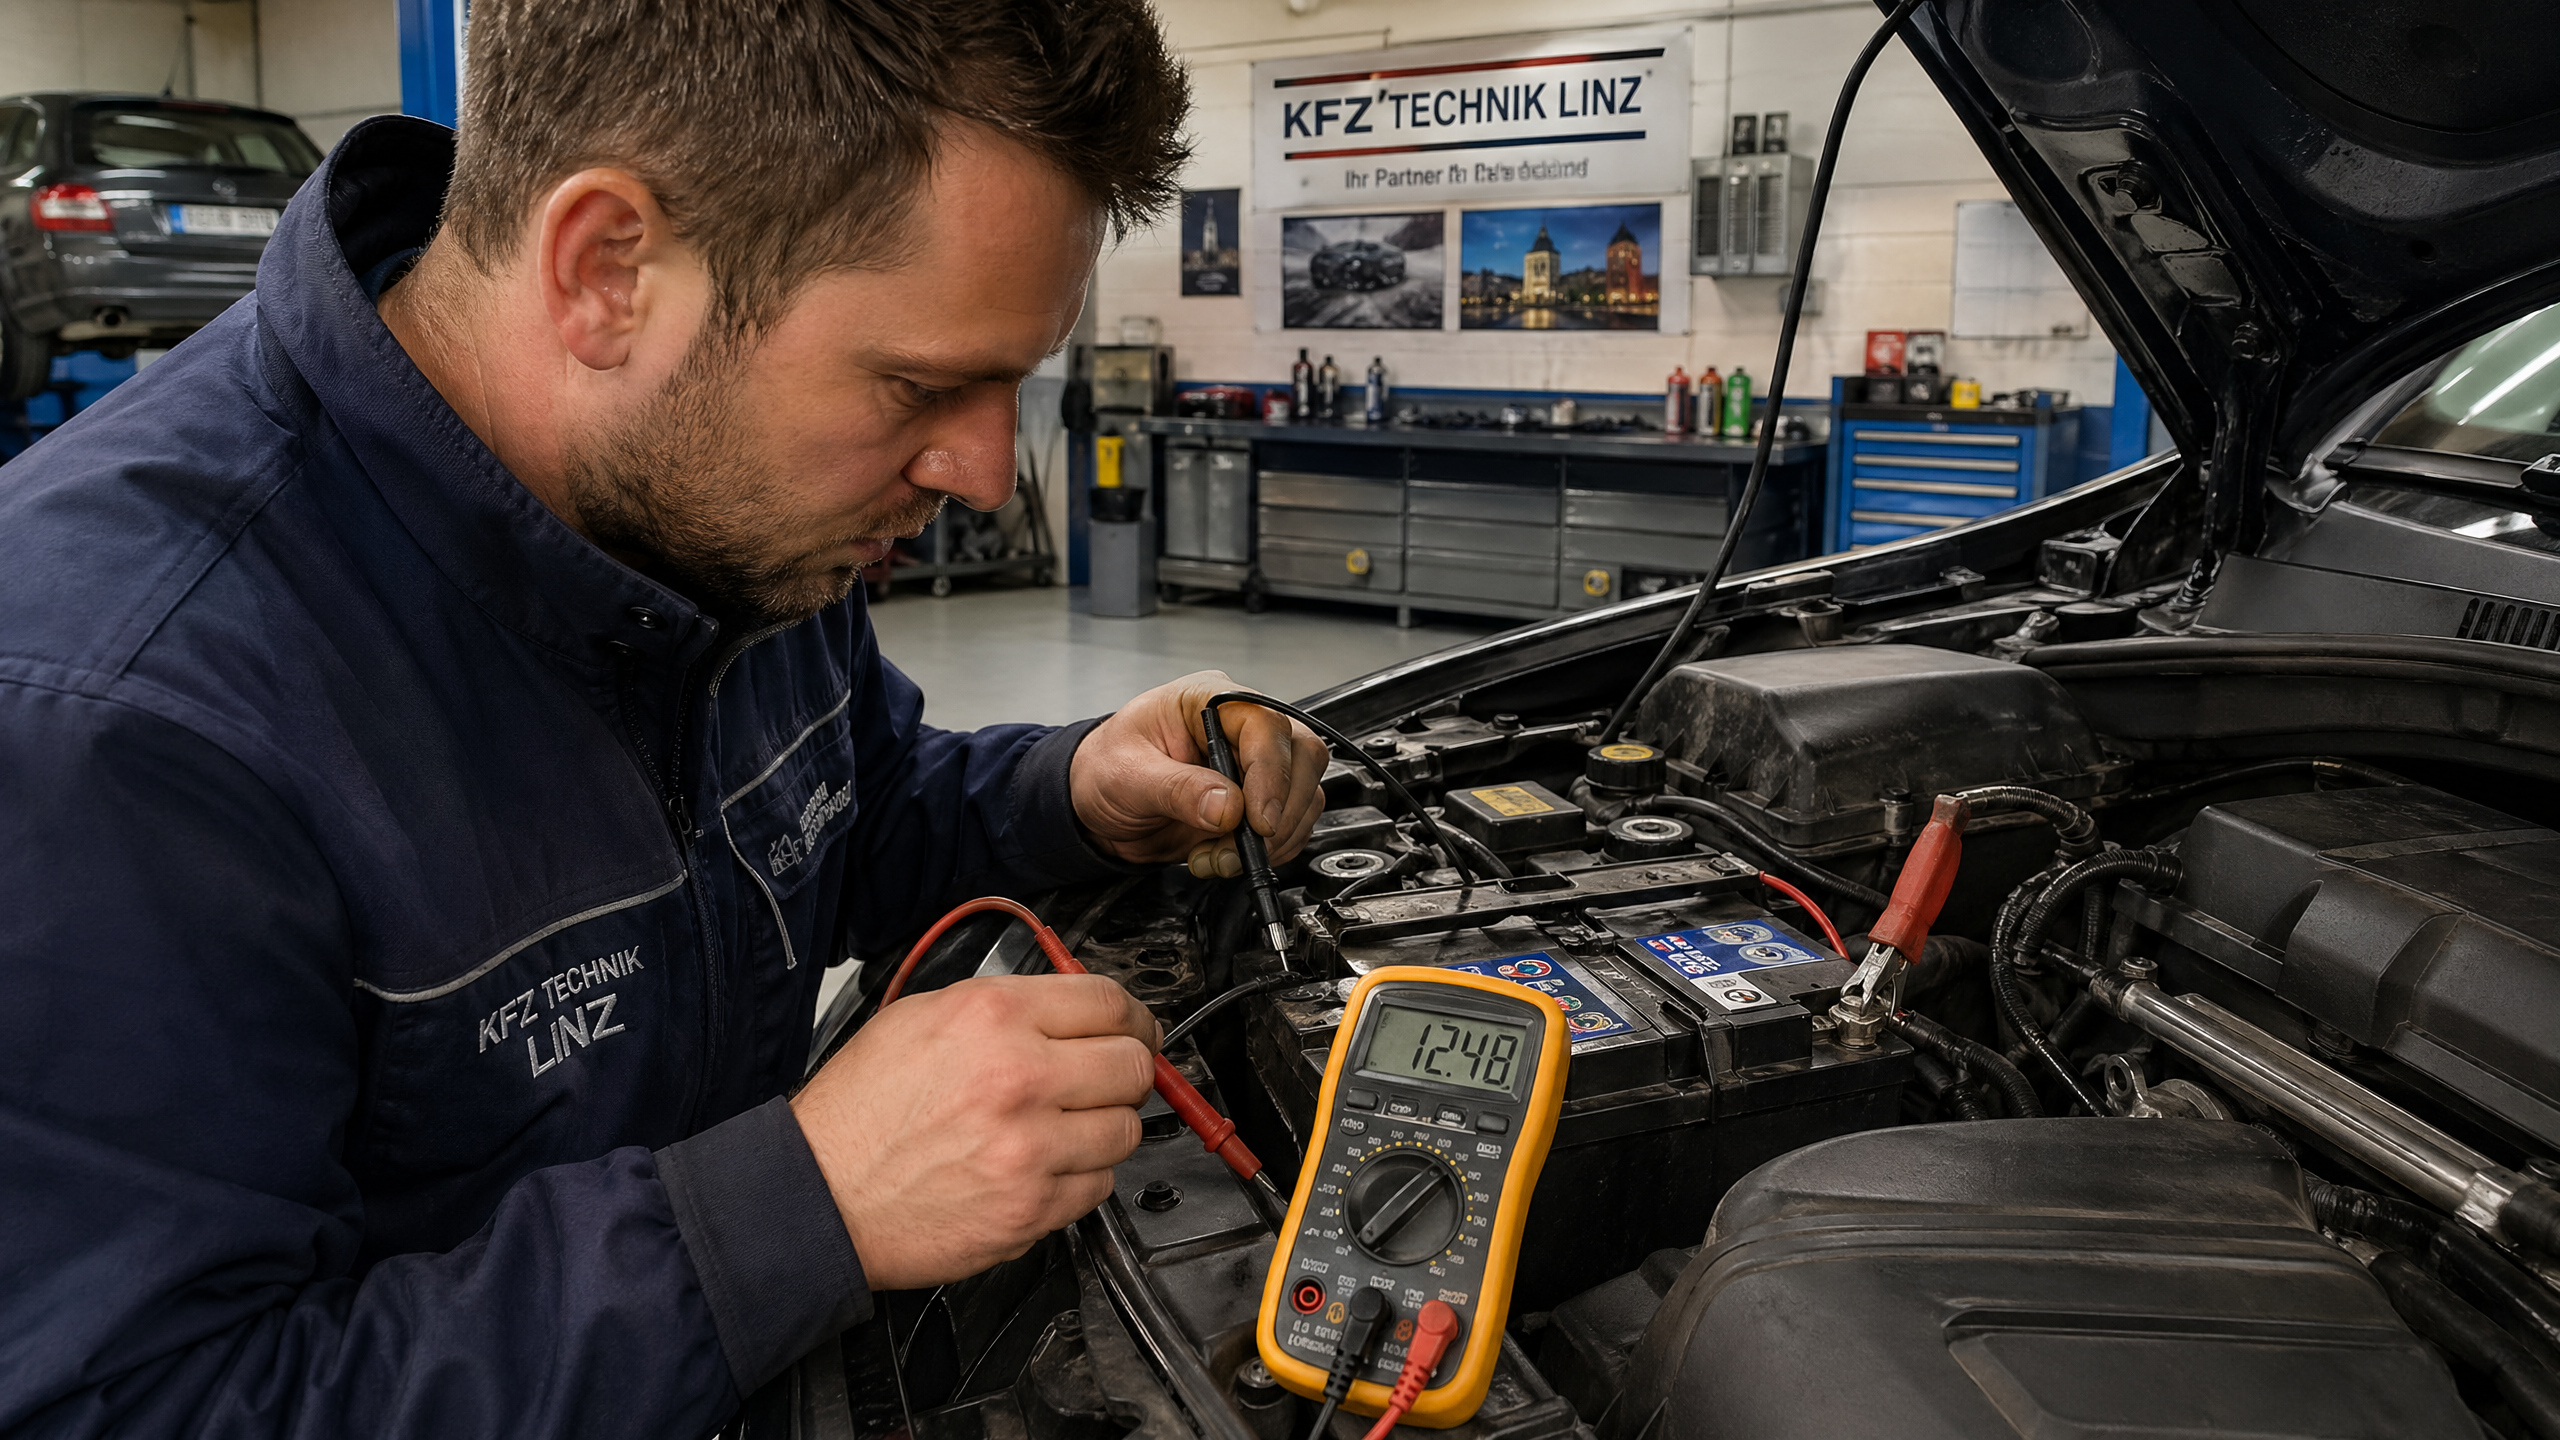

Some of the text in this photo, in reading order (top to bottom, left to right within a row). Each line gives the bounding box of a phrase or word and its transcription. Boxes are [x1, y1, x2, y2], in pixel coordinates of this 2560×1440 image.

[1559, 76, 1642, 118] LINZ
[1345, 170, 1369, 189] Ihr
[1375, 166, 1443, 188] Partner
[479, 945, 644, 1054] KFZ TECHNIK
[527, 993, 626, 1078] LINZ
[1412, 1023, 1518, 1086] 12.48
